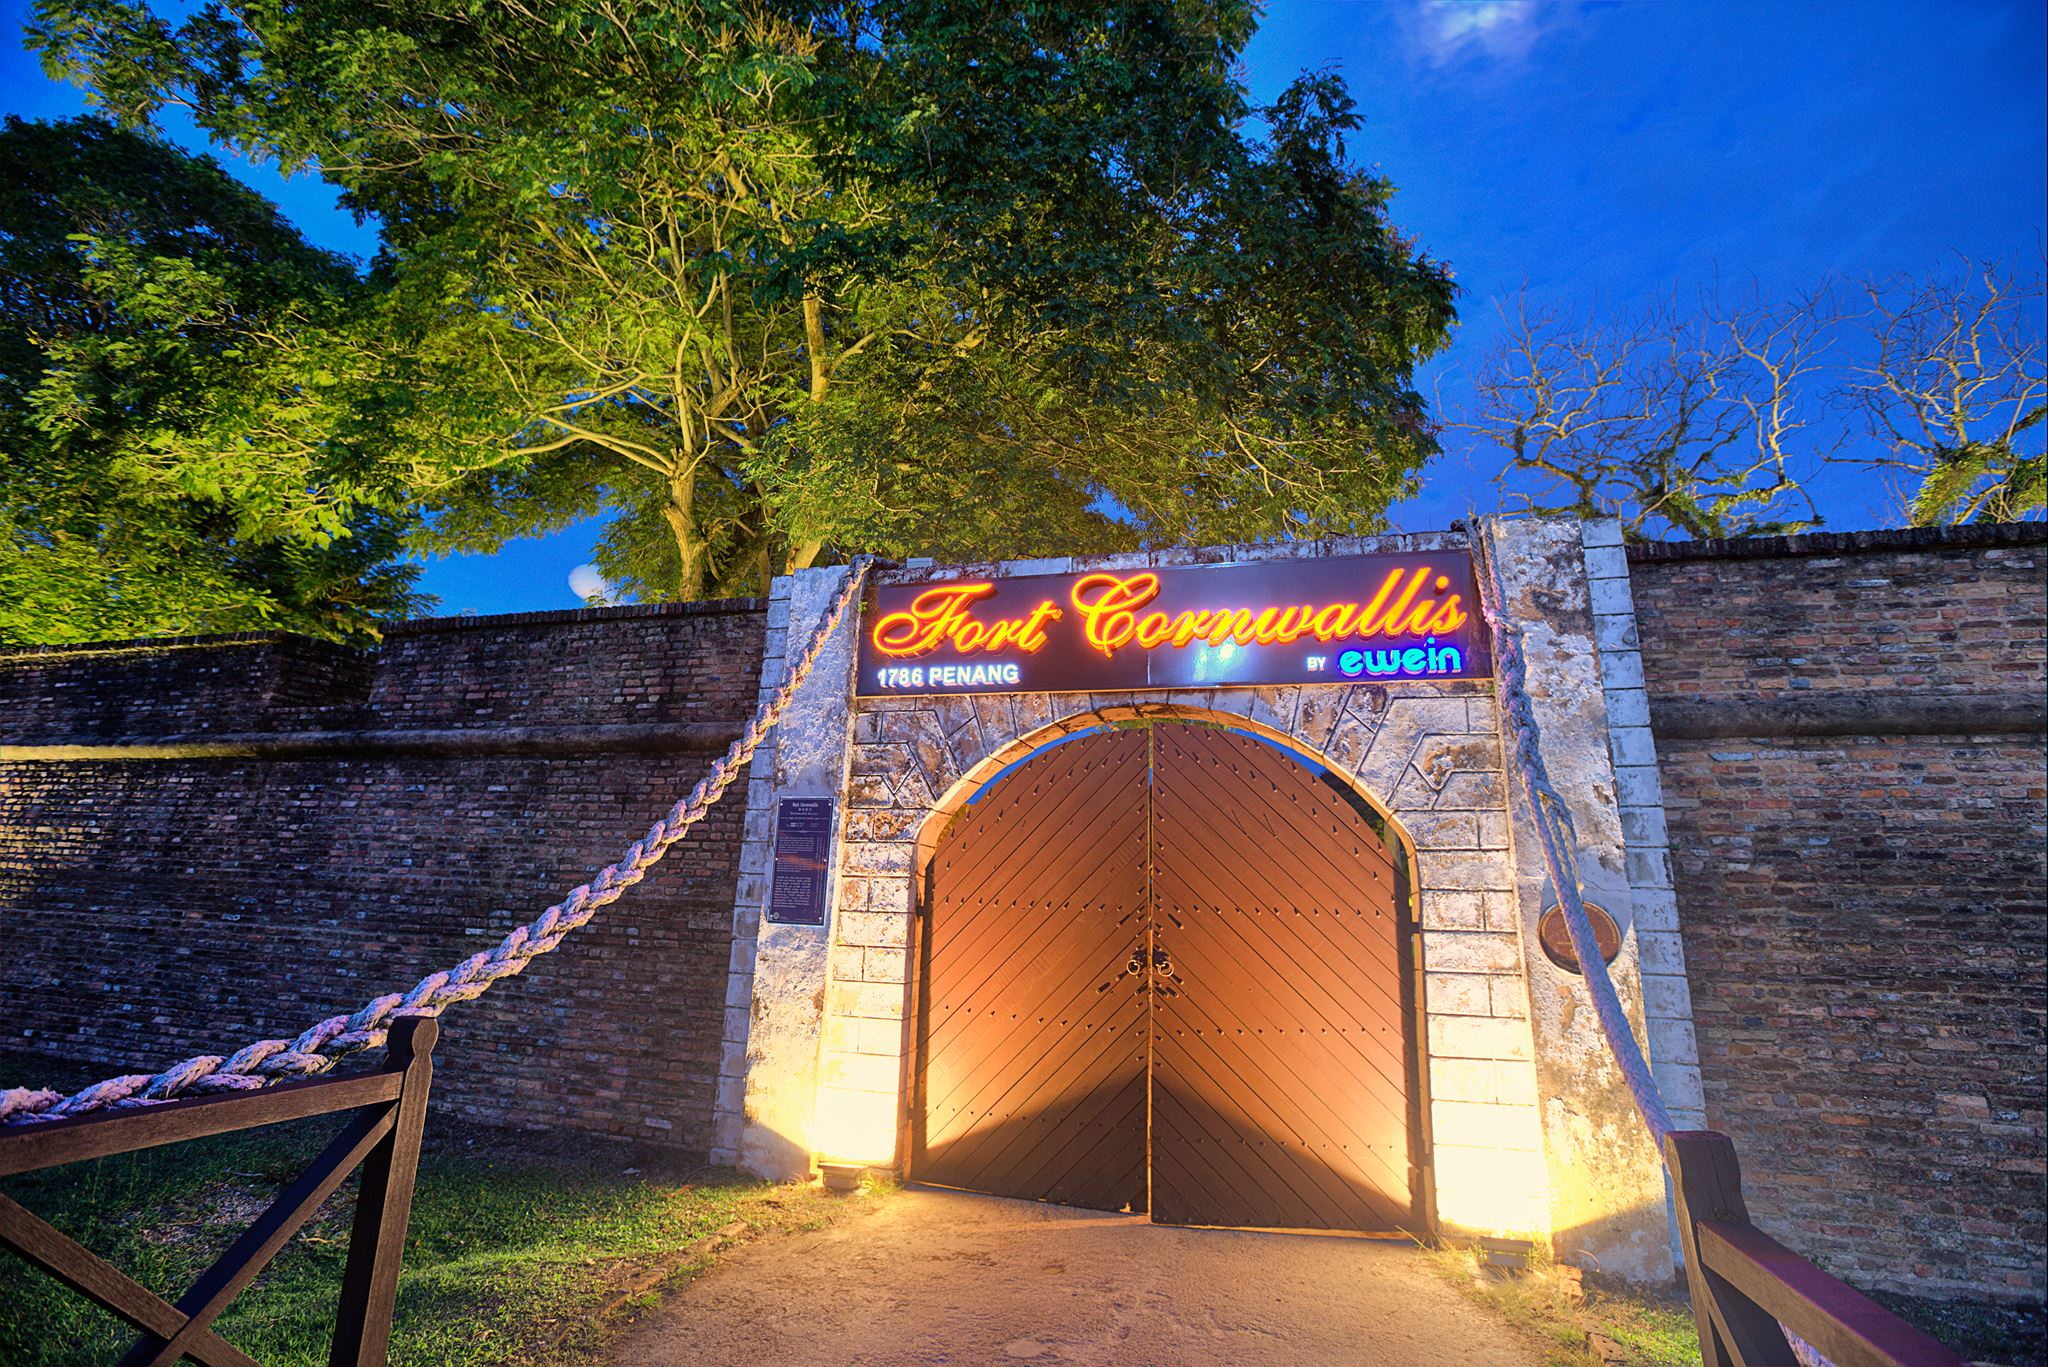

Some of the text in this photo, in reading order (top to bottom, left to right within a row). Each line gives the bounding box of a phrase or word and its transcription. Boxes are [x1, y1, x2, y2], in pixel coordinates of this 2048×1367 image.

[873, 567, 1468, 658] Fort Cornwallis
[878, 664, 1021, 687] 1786 PENANG
[1307, 637, 1462, 676] BY ewein
